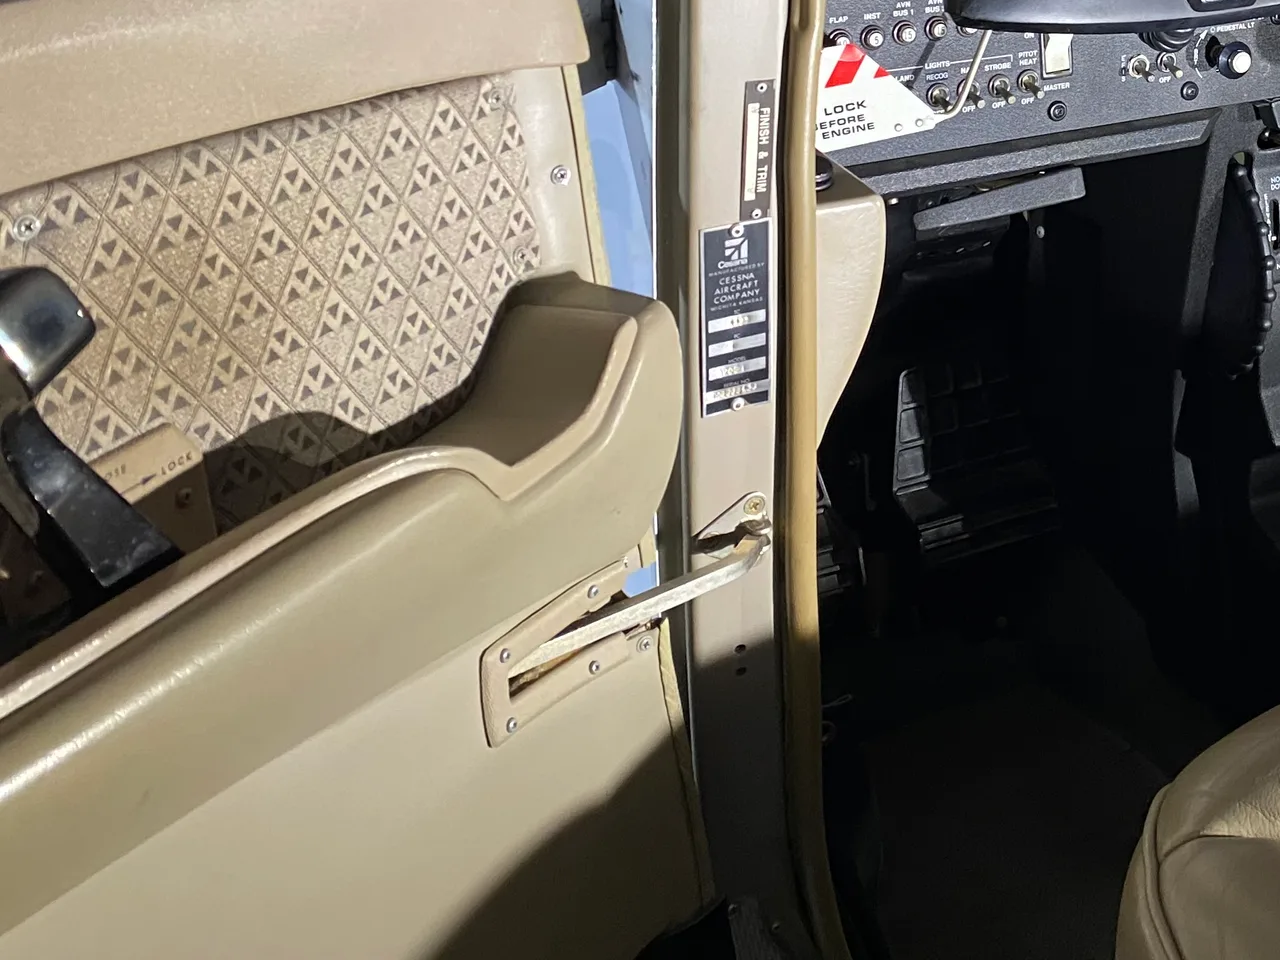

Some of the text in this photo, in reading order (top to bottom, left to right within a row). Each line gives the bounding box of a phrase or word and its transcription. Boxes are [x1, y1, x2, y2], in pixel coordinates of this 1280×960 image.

[893, 8, 909, 17] BUS
[925, 6, 938, 14] BUS
[896, 1, 911, 9] AVN
[829, 12, 882, 24] FLAP INST
[903, 30, 913, 39] 15
[1216, 23, 1246, 33] PEDESTAL
[1018, 50, 1038, 59] PITOT
[925, 61, 951, 70] LIGHTS
[1019, 57, 1037, 66] HEAT
[926, 72, 949, 81] RECOG
[960, 66, 970, 75] NA
[984, 61, 1012, 72] STROBE
[1159, 75, 1172, 84] OFF
[1043, 82, 1071, 92] MASTER
[823, 99, 867, 116] LOCK
[961, 97, 1035, 113] OFF OFF OFF
[822, 122, 875, 140] ENGINE
[756, 107, 771, 193] FINISH & TRIM
[708, 263, 757, 277] MANUFACTURED
[718, 259, 748, 269] Cessna
[719, 272, 755, 286] CESSNA
[714, 280, 759, 296] AIRCRAFT
[713, 288, 761, 305] COMPANY
[710, 296, 763, 312] WICHITA KANSAS
[160, 452, 194, 477] LOCK
